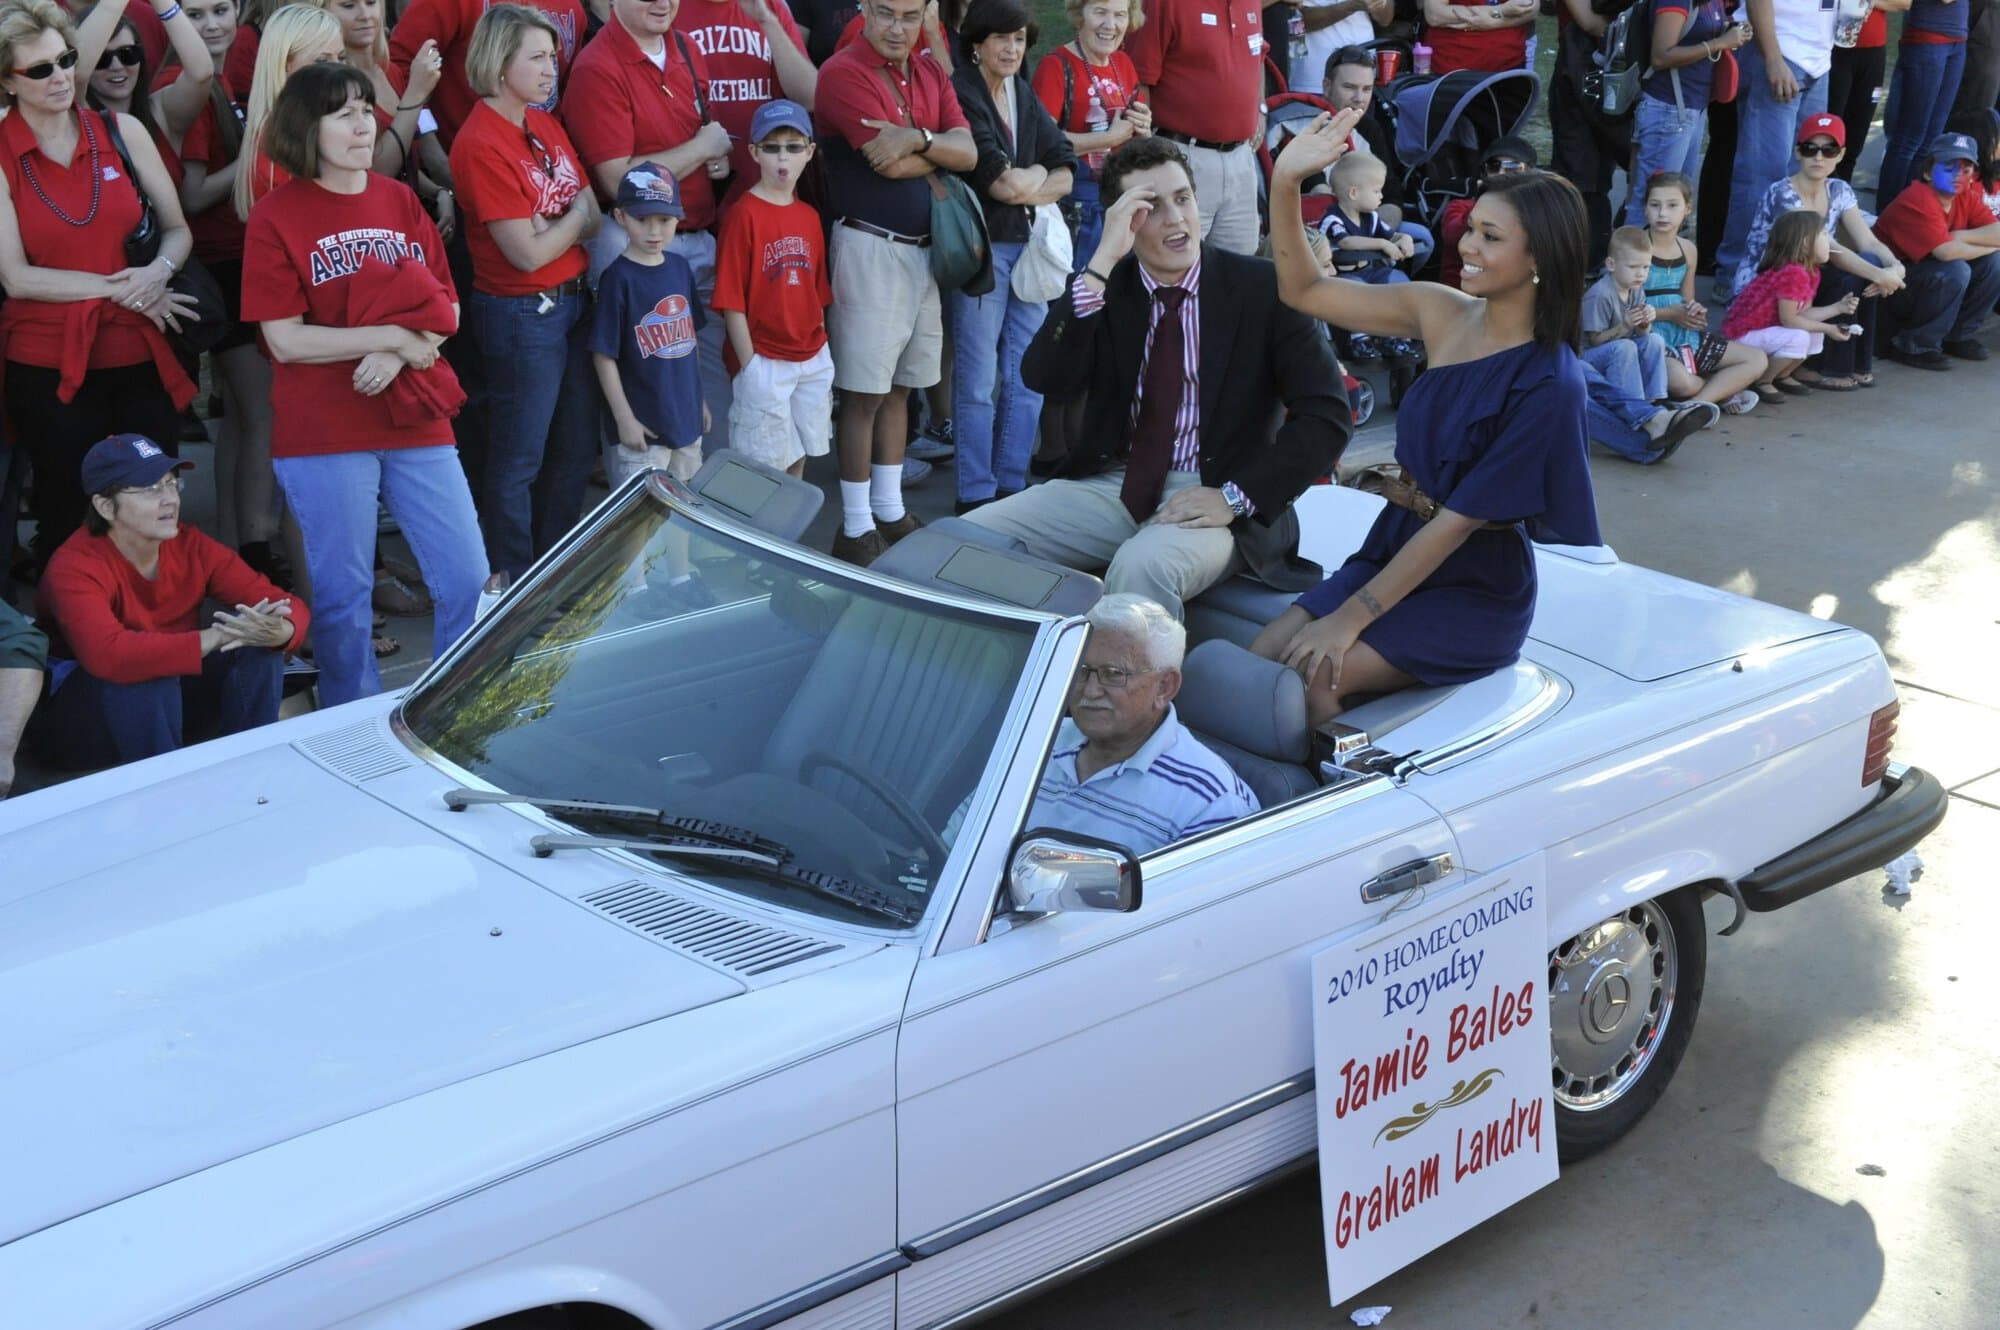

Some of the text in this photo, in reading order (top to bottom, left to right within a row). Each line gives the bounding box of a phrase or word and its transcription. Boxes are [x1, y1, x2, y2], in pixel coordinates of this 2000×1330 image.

[688, 25, 772, 64] RIZONA
[317, 228, 406, 249] THE UNIVERSITY OF
[1328, 886, 1533, 1003] 2010 HOMECOMING
[1383, 948, 1484, 1017] Royalty
[1336, 982, 1533, 1119] Jamie Bales
[1335, 1097, 1542, 1249] Graham Landry
